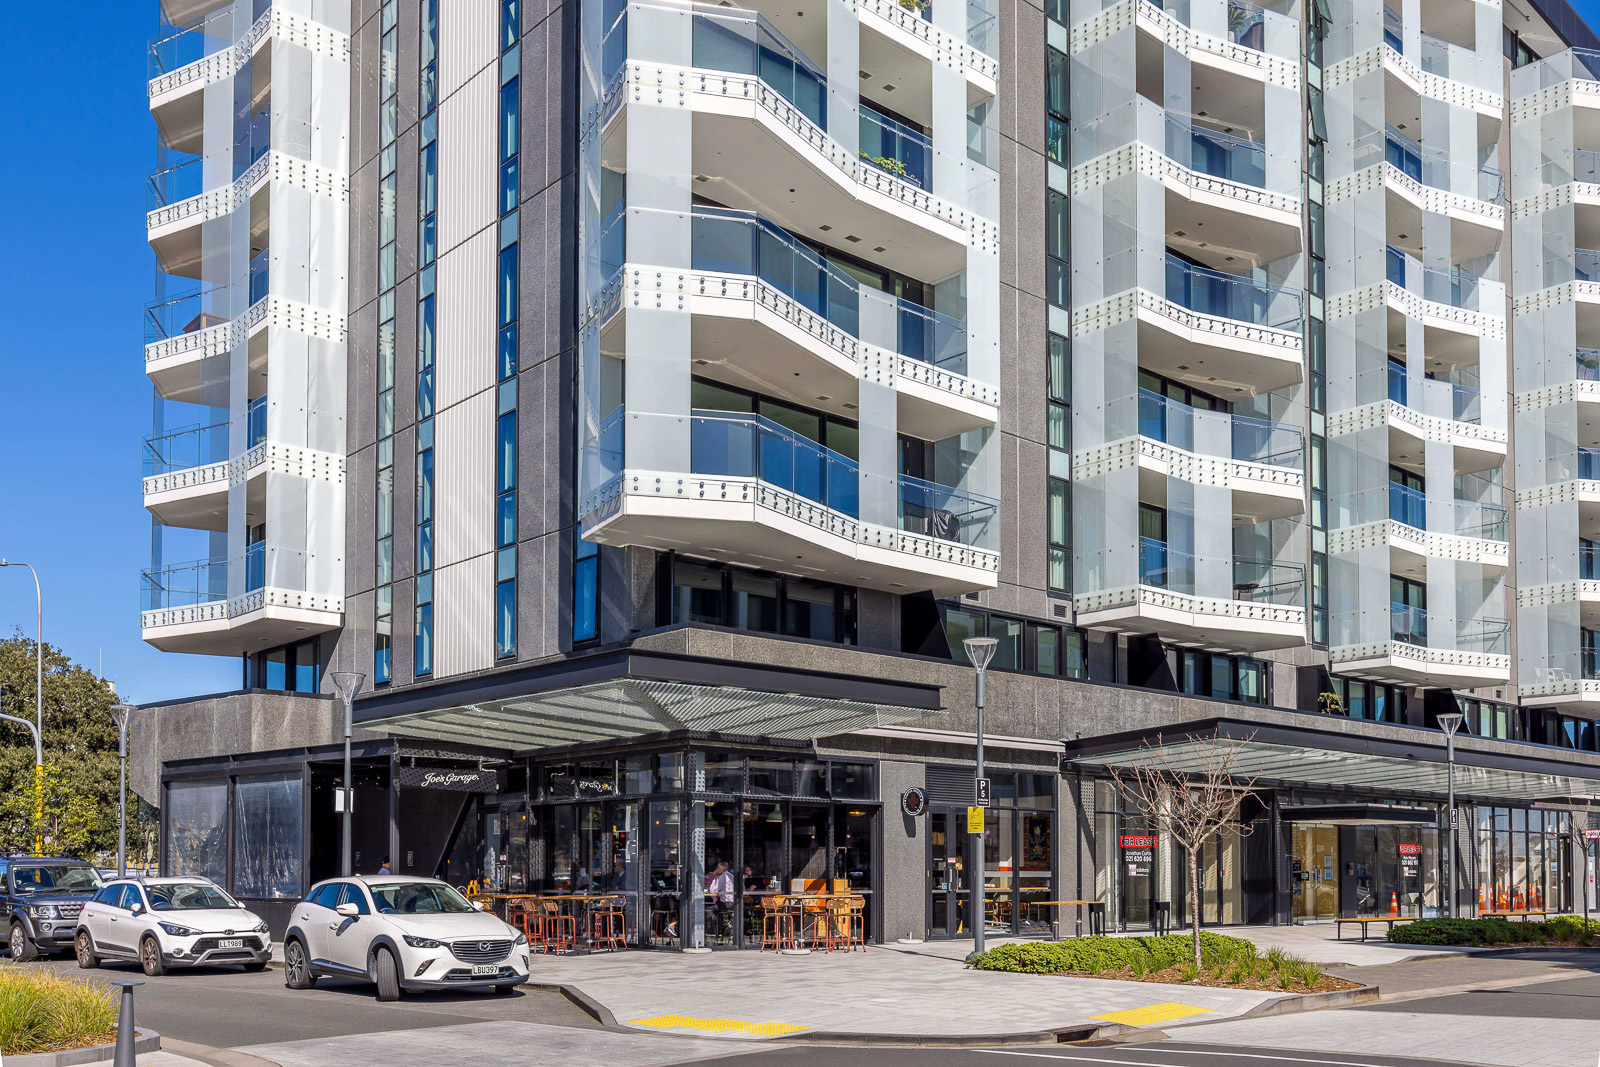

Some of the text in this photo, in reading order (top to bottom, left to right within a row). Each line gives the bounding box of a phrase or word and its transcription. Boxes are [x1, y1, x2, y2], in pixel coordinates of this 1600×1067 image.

[421, 772, 445, 787] Joe's
[980, 780, 986, 790] P
[980, 790, 986, 798] 5
[1121, 838, 1134, 846] FOR
[473, 966, 498, 974] LBU397
